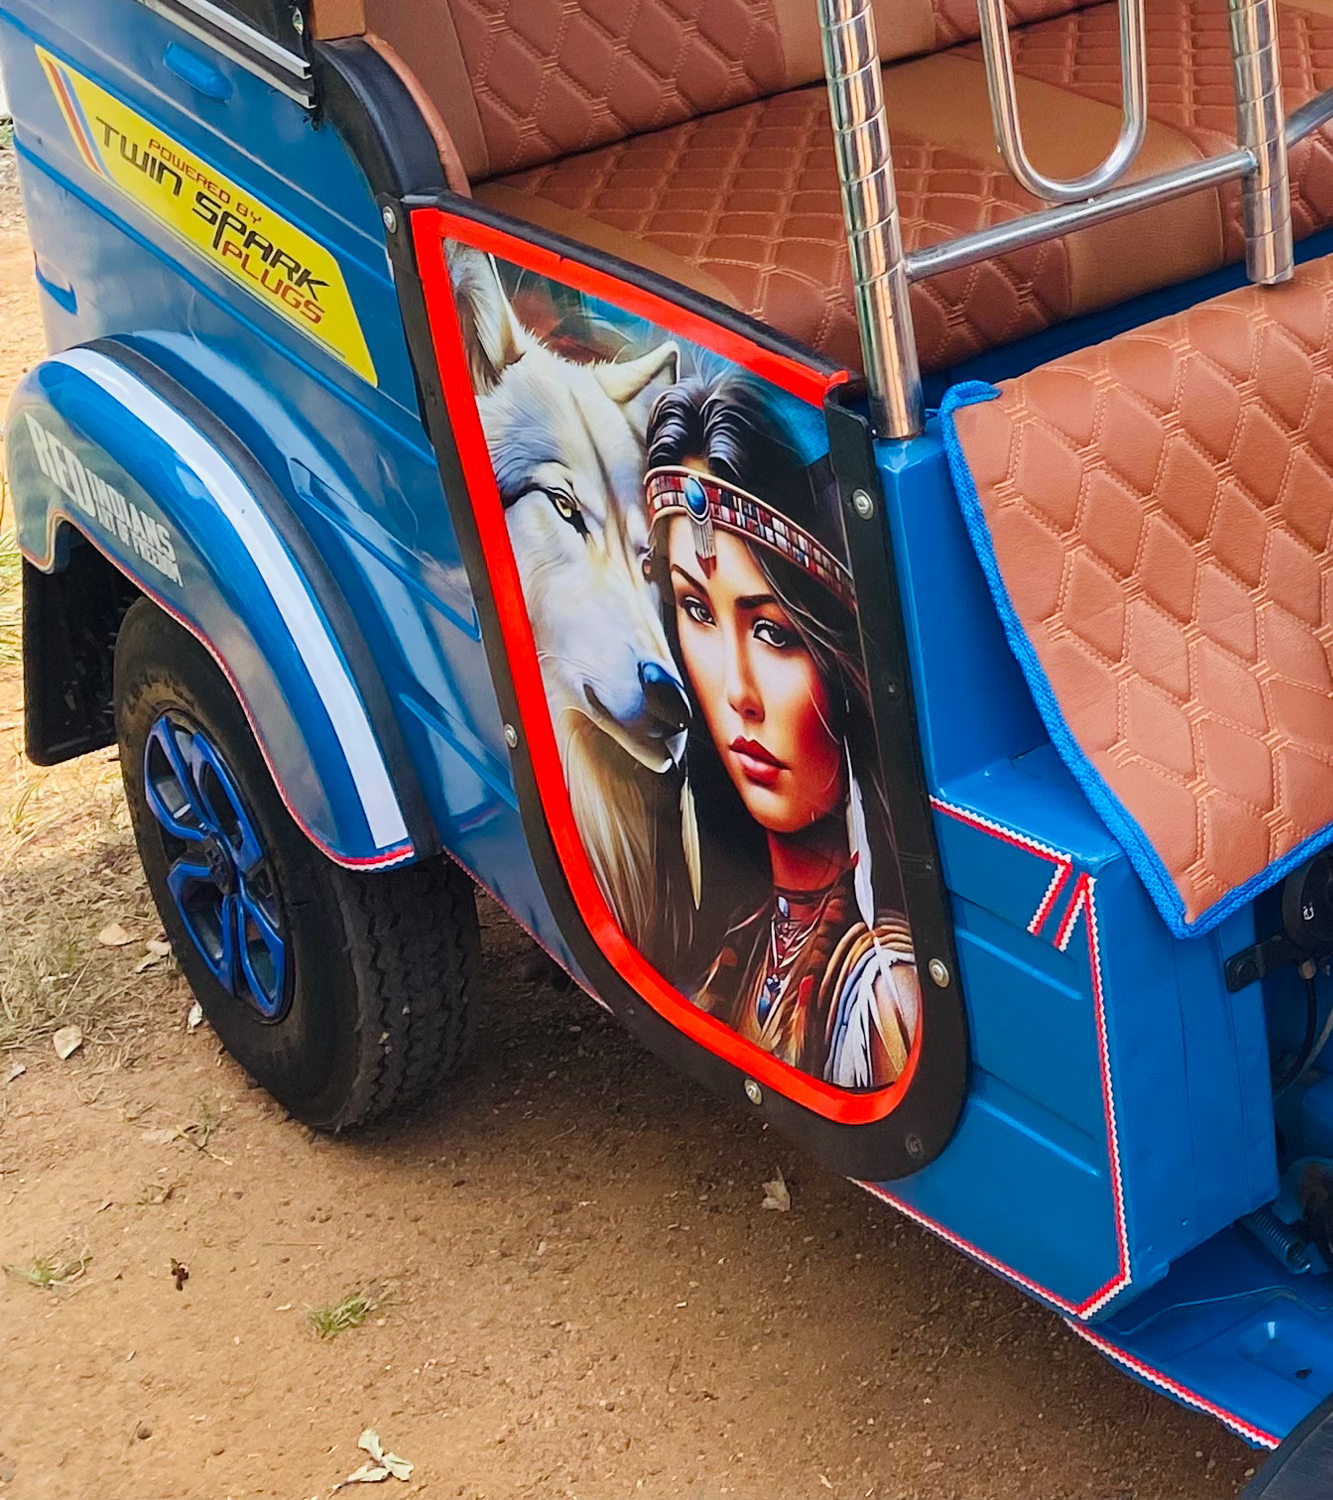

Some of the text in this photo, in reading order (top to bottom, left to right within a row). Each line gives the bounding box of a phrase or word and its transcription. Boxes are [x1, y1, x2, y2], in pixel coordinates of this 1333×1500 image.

[96, 116, 331, 302] TWIN SPARK
[148, 138, 262, 225] POWERED BY
[221, 240, 325, 325] PLUGS
[25, 411, 96, 518] RED
[85, 467, 176, 562] INDIANS
